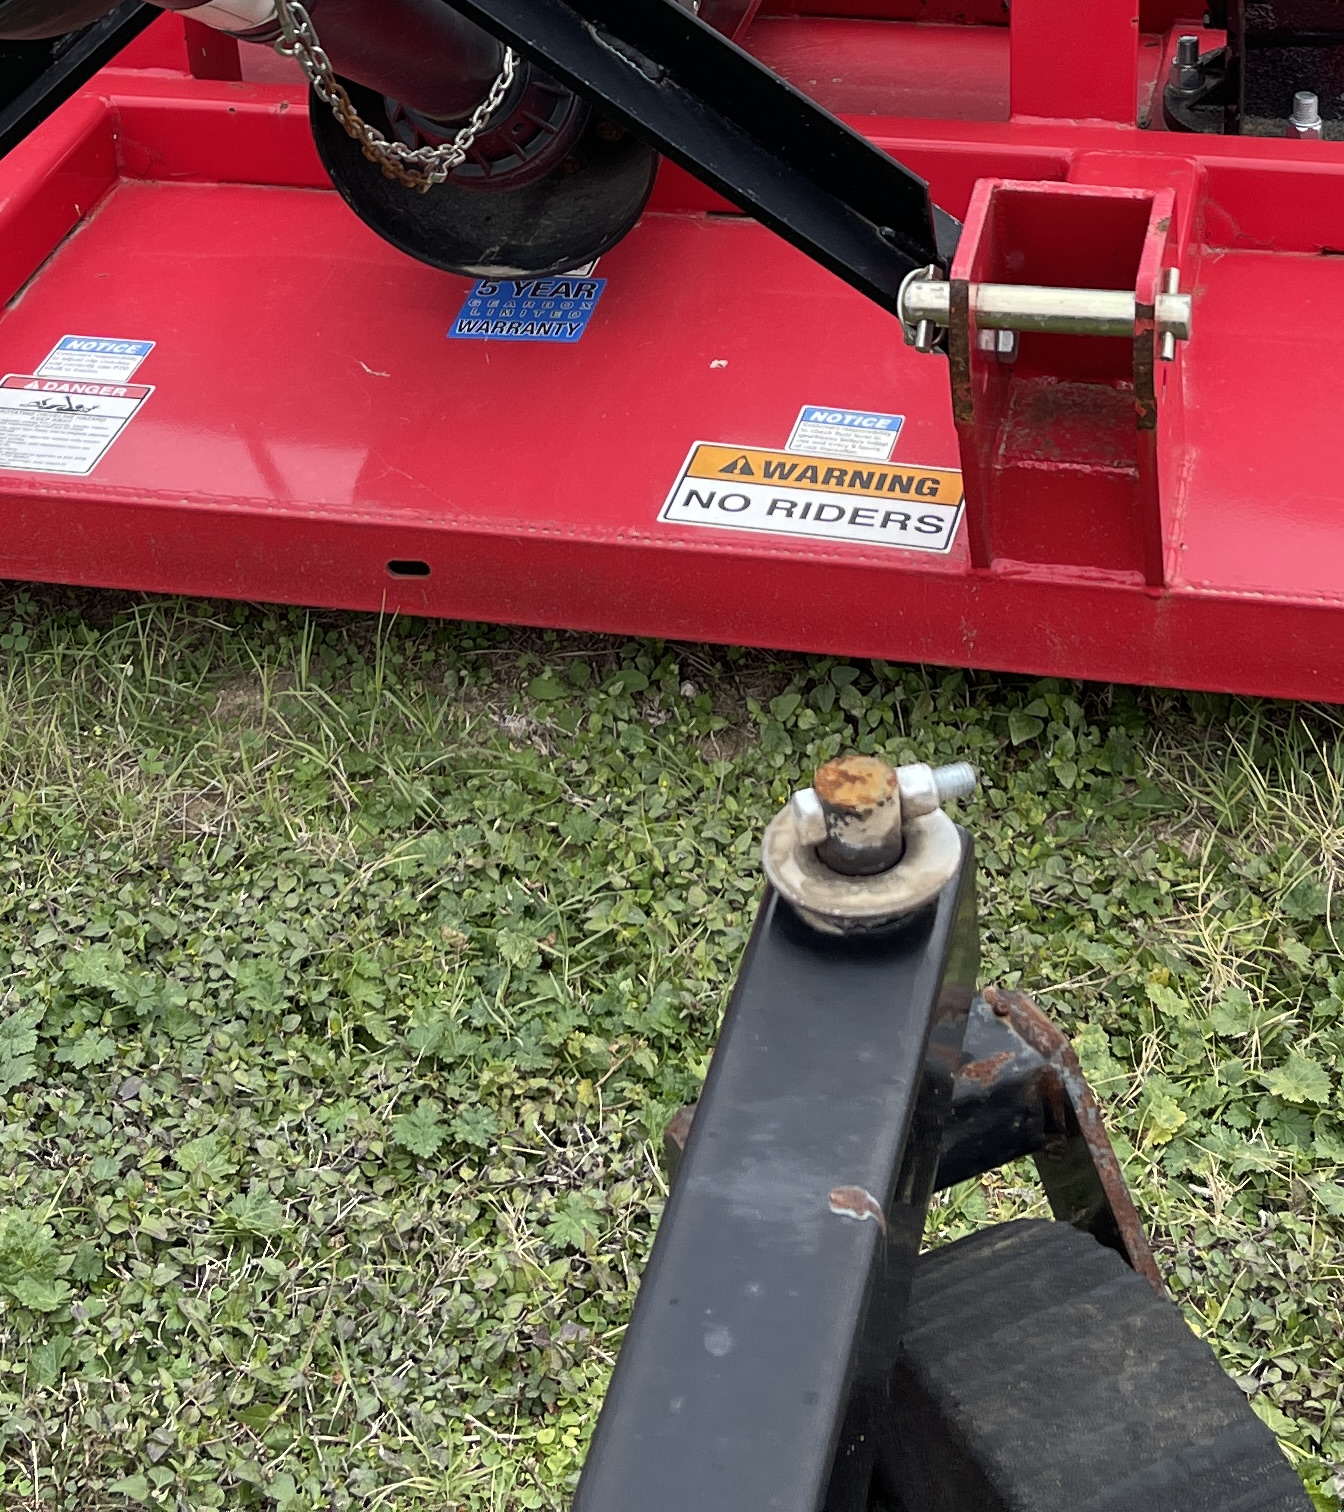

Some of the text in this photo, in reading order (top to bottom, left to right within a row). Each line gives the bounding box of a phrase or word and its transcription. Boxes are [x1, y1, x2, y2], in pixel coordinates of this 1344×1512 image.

[476, 279, 599, 299] 5 YEAR
[468, 299, 594, 310] GEARBOX
[470, 308, 582, 319] LIMITED
[456, 318, 583, 337] WARRANTY
[66, 340, 142, 354] NOTICE
[42, 381, 128, 396] DANGER
[810, 411, 892, 428] NOTICE
[762, 459, 941, 498] WARNING
[682, 489, 946, 535] NO RIDERS
